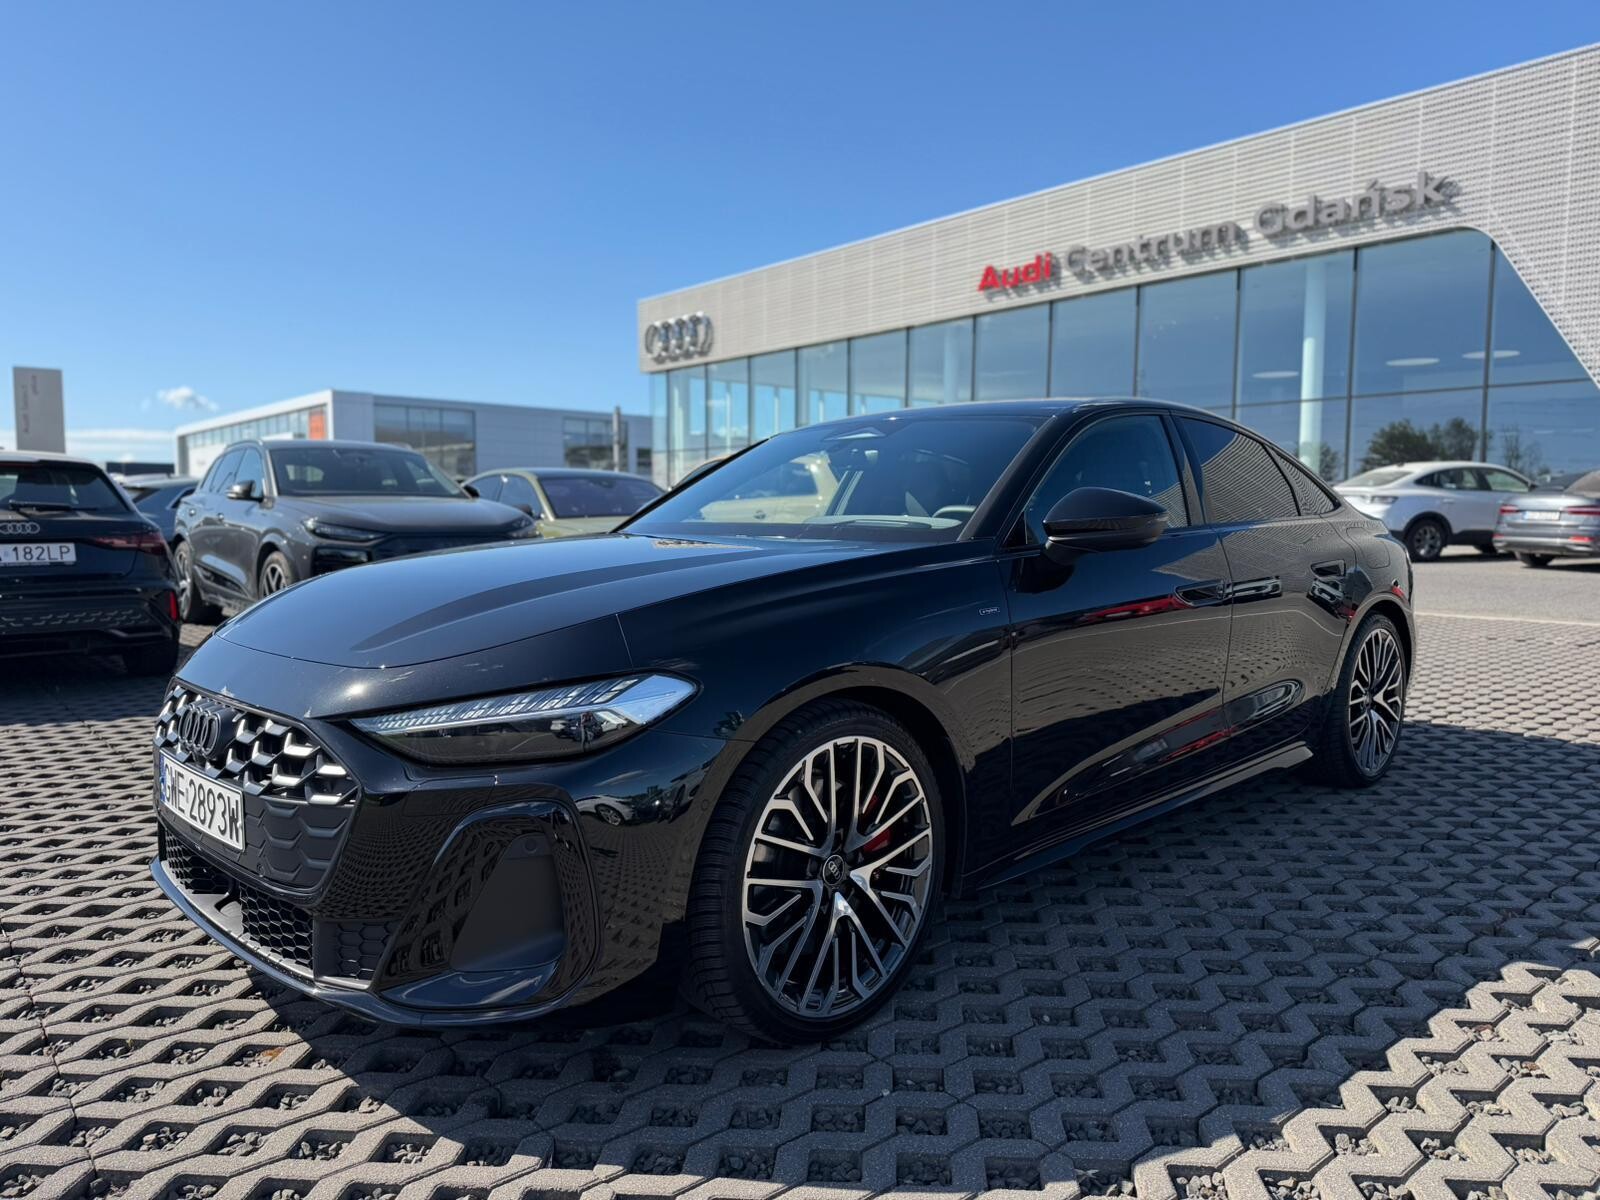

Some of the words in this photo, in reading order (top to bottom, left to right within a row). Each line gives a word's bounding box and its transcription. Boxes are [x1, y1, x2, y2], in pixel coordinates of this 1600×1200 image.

[978, 252, 1052, 291] Audi
[1064, 221, 1238, 272] Centrum
[1254, 171, 1448, 235] Gdańsk
[12, 545, 71, 561] 182LP
[189, 778, 240, 843] 2893W
